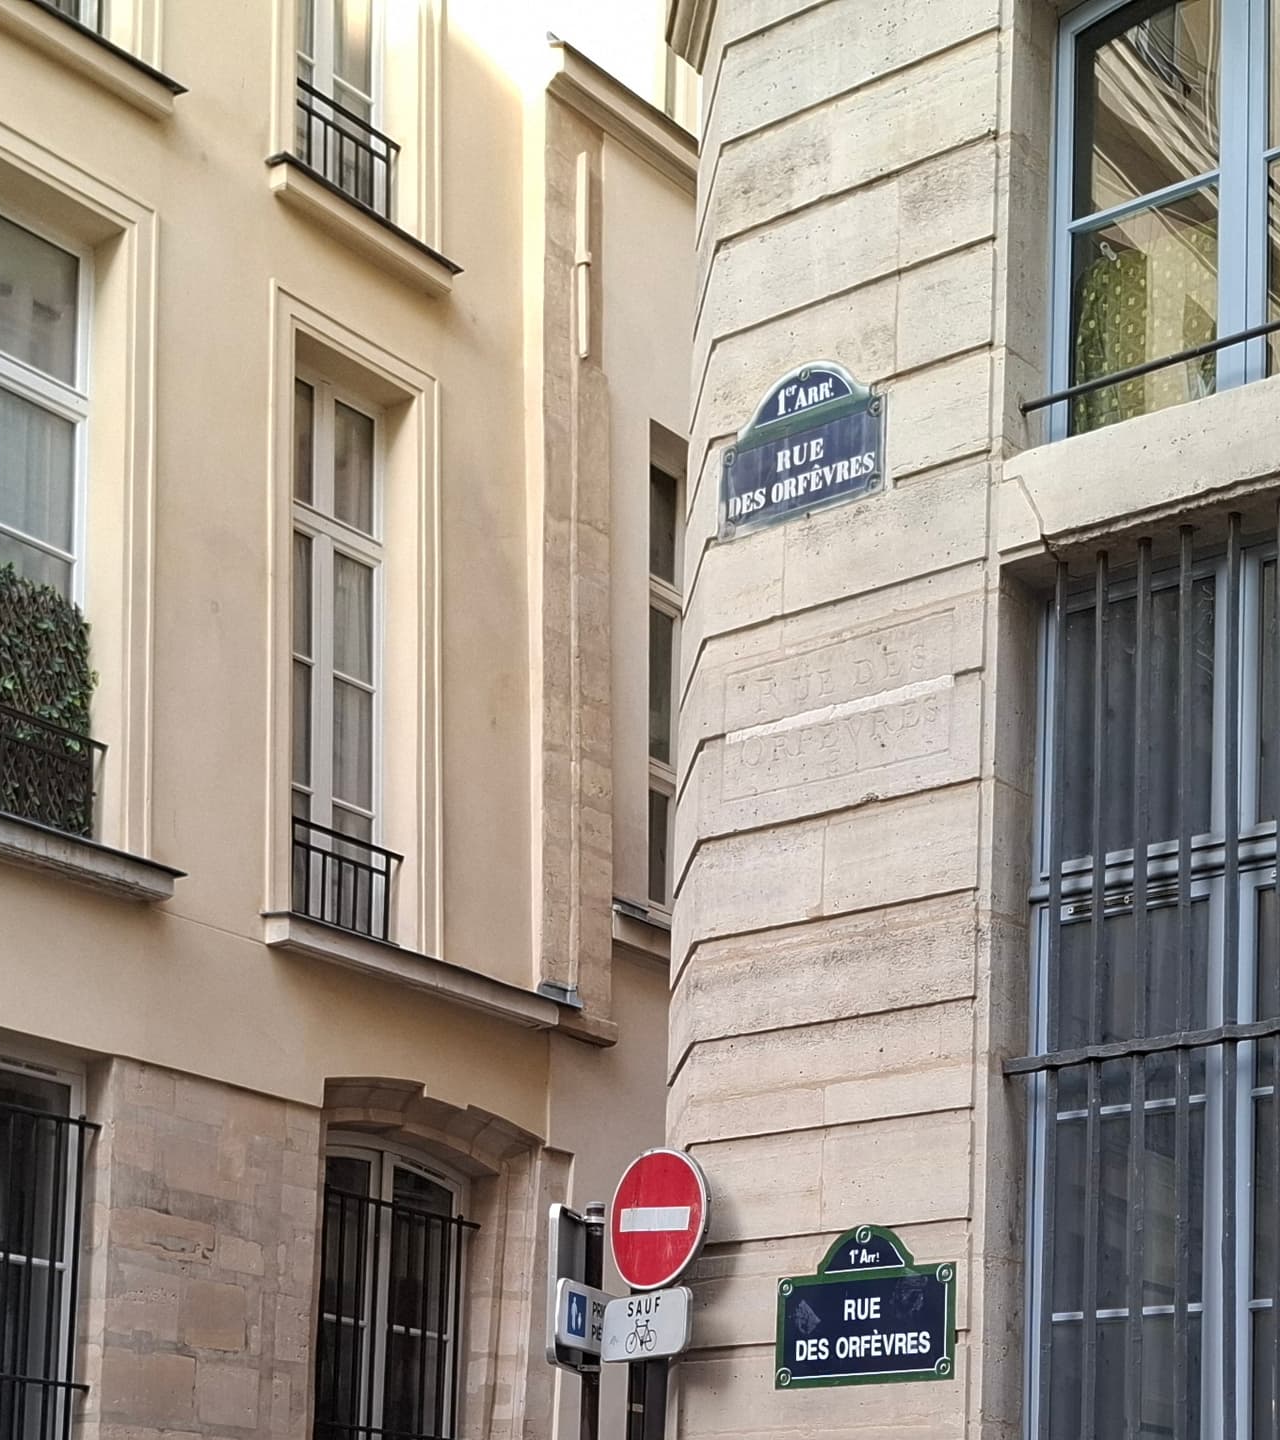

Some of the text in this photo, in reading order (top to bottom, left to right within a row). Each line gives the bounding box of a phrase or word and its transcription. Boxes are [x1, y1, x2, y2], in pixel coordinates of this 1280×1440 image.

[776, 438, 824, 472] RUE
[727, 487, 767, 520] DES
[627, 1297, 661, 1317] SAUF
[843, 1297, 881, 1321] RUE
[795, 1329, 931, 1362] DES ORFÈVRES
